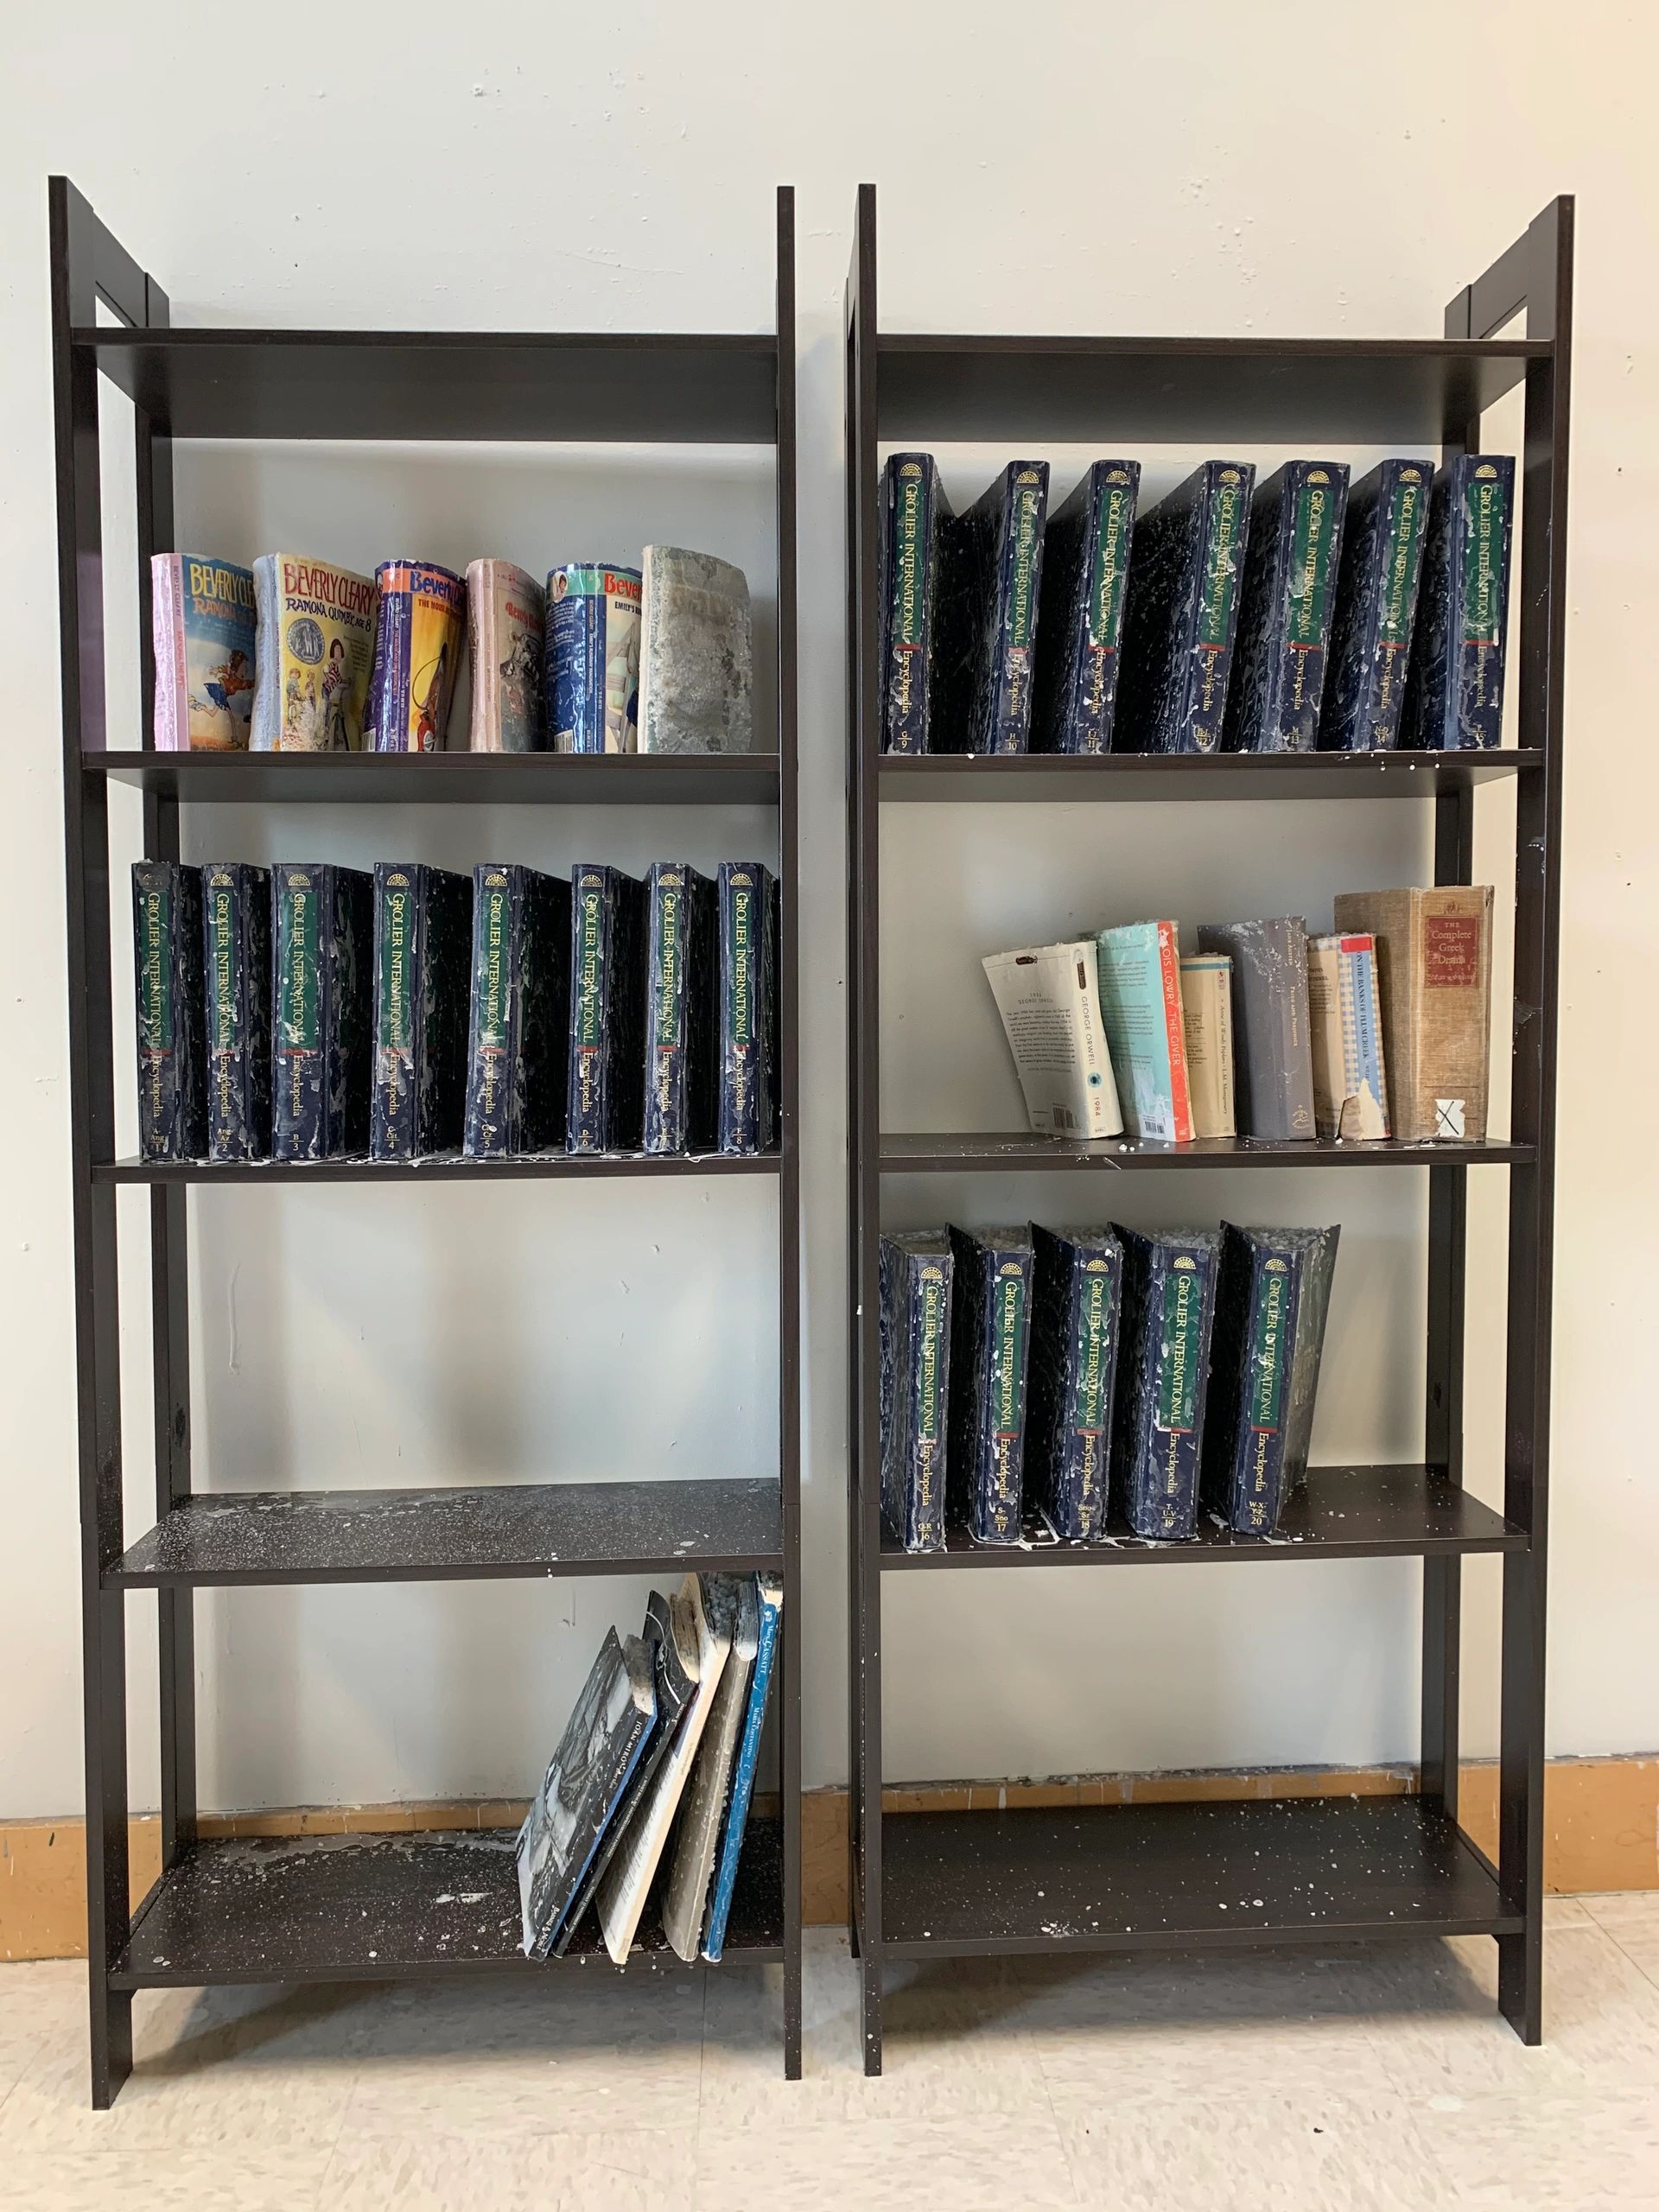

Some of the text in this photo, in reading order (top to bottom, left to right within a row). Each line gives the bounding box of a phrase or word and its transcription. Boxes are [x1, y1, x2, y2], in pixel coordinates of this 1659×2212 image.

[189, 563, 238, 603] BEVERLY
[238, 575, 256, 609] CLE
[284, 563, 338, 605] BEVERLY
[338, 577, 374, 616] CLEARY
[418, 599, 429, 607] THE
[604, 573, 642, 603] Bever
[900, 484, 918, 714] GROLIER INTERNATIONAL Encyclopedia
[1009, 491, 1033, 715] GROLIER INTERNATIONAL Encyclopedia
[1090, 490, 1123, 714] GROLIER INTERNATIONAL Encyclopedia
[1202, 489, 1235, 711] GROLIER INTERNATIONAL Encyclopedia
[1294, 490, 1324, 710] GROLIER INTERNATIONAL Encyclopedia
[1381, 489, 1415, 709] GROLIER INTERNATIONAL Encyclopedia
[1475, 485, 1493, 707] GROLIER INTERNATIONAL Encyclopedia
[285, 597, 372, 632] RAMONA QUIMBY, AGE 8
[614, 601, 635, 613] EMILY'S
[901, 740, 907, 748] 9
[1290, 735, 1299, 744] 13
[1432, 930, 1471, 941] Complete
[1439, 942, 1465, 952] Greek
[1356, 951, 1363, 962] ON
[149, 893, 164, 1117] GROLIER INTERNATIONAL Encyclopedia
[217, 893, 232, 1117] GROLIER INTERNATIONAL Encyclopedia
[290, 893, 304, 1116] GROLIER INTERNATIONAL Encyclopedia
[387, 893, 404, 1115] GROLIER INTERNATIONAL Encyclopedia
[484, 893, 503, 1114] GROLIER INTERNATIONAL Encyclopedia
[581, 893, 597, 1112] GROLIER INTERNATIONAL Encyclopedia
[659, 893, 676, 1111] GROLIER INTERNATIONAL Encyclopedia
[734, 893, 747, 1110] GROLIER INTERNATIONAL Encyclopedia
[1164, 970, 1174, 1007] LOWRY
[1357, 979, 1366, 1002] BANKS
[1359, 1004, 1367, 1014] OF
[1081, 996, 1090, 1031] GEORGE
[1168, 1011, 1178, 1033] THE
[1085, 1033, 1095, 1065] ORWELL
[1170, 1035, 1180, 1065] GIVER
[484, 1140, 490, 1148] 5
[1267, 1278, 1281, 1329] GROLIER
[920, 1286, 938, 1506] GROLIER INTERNATIONAL Encyclopedia
[997, 1281, 1017, 1498] GROLIER INTERNATIONAL Encyclopedia
[1081, 1279, 1103, 1496] GROLIER INTERNATIONAL Encyclopedia
[1165, 1275, 1190, 1493] GROLIER INTERNATIONAL Encyclopedia
[1255, 1433, 1269, 1492] Encyclopedia
[920, 1532, 930, 1541] 16
[1081, 1521, 1090, 1529] 18
[1165, 1519, 1174, 1528] 19
[1250, 1516, 1262, 1525] 20
[760, 1625, 774, 1674] Mary CASSATT
[630, 1720, 643, 1741] JOAN
[545, 1906, 560, 1926] BARNES
[537, 1931, 549, 1950] NOBLE
